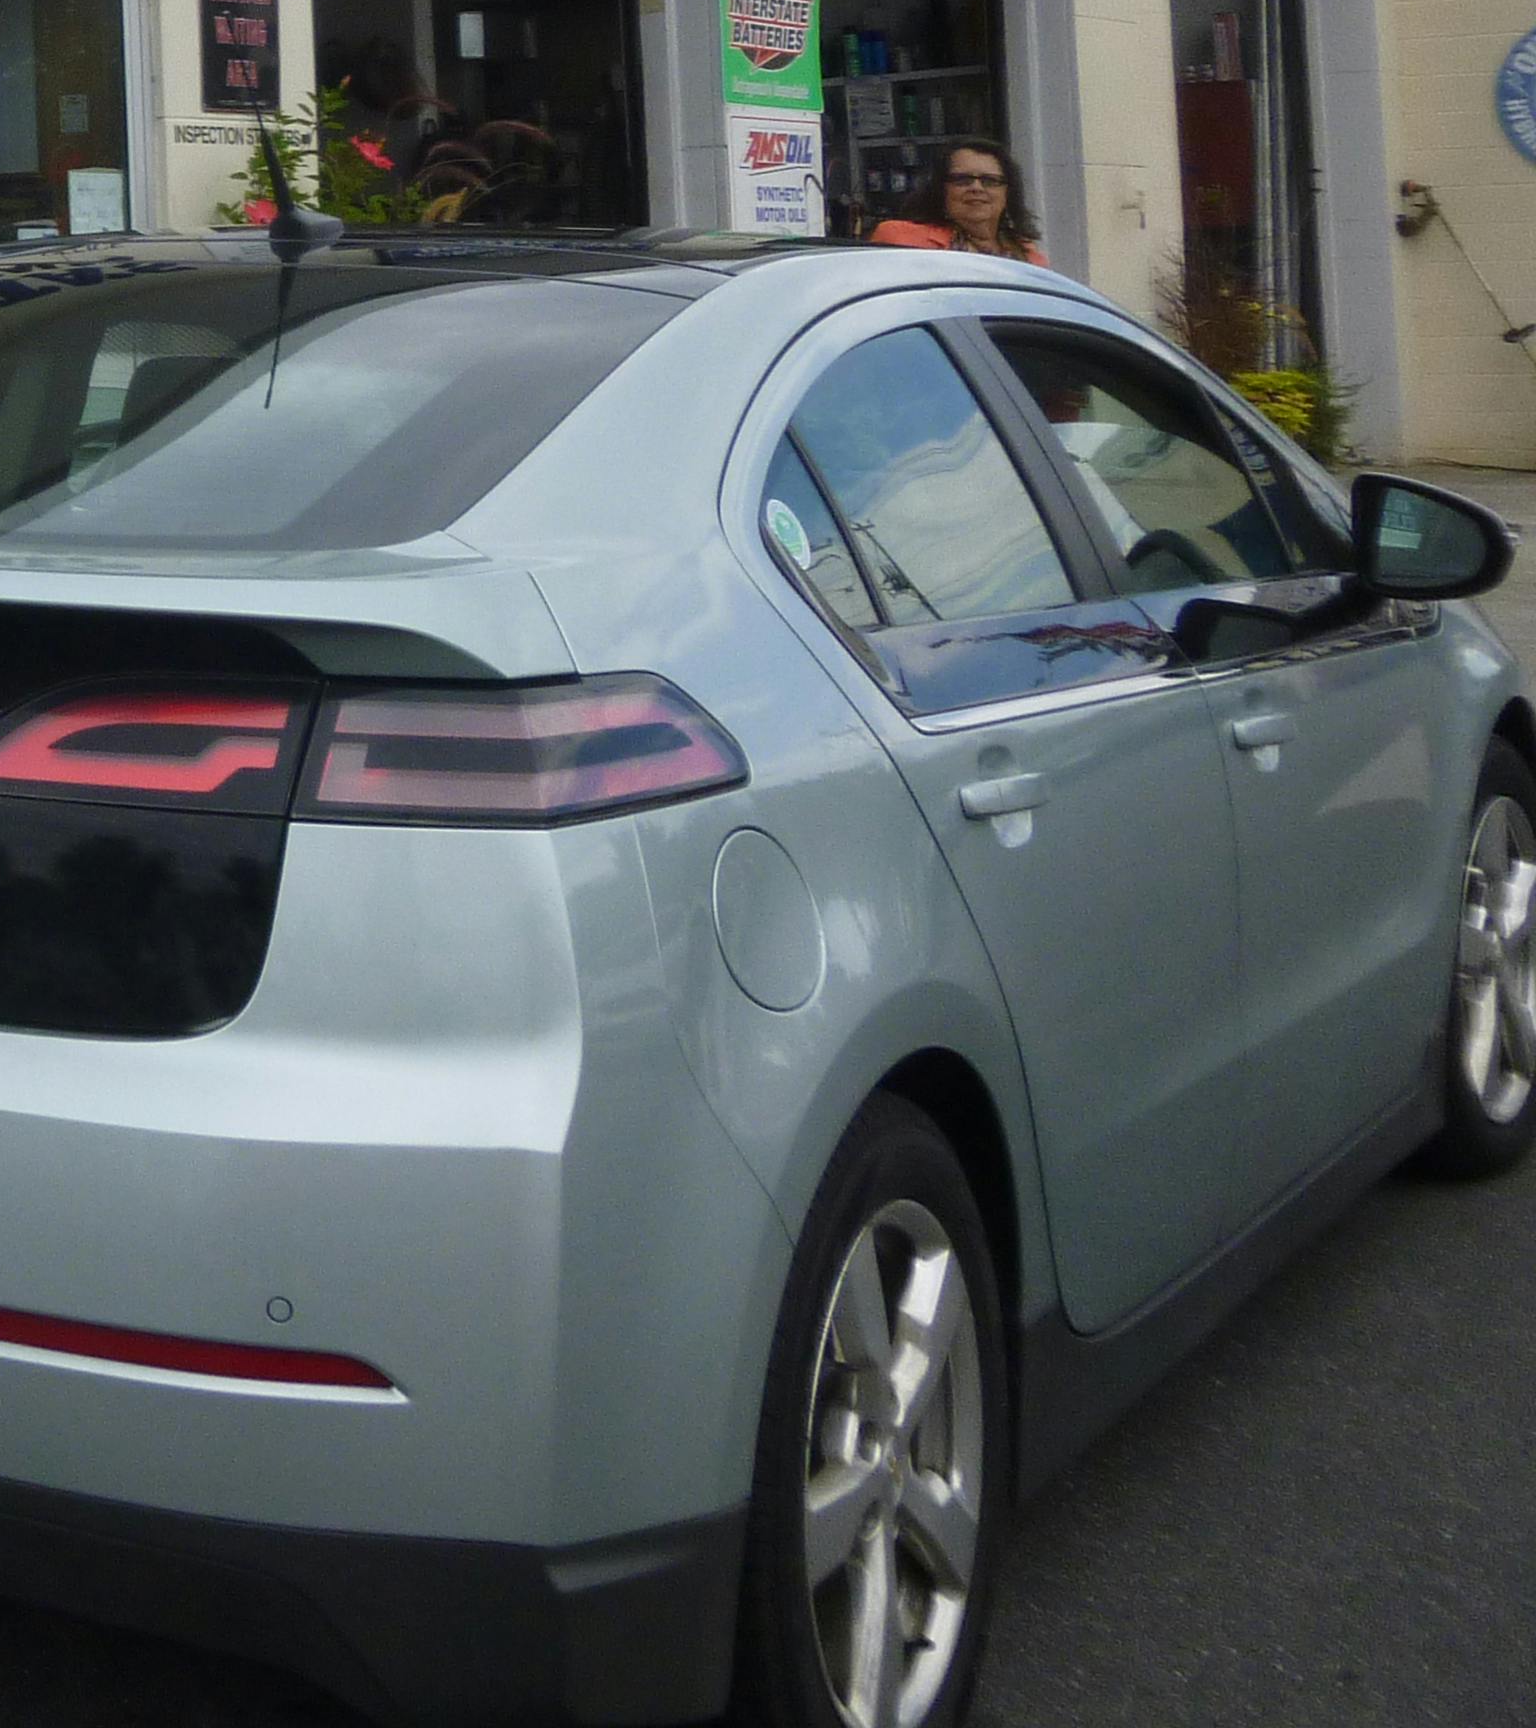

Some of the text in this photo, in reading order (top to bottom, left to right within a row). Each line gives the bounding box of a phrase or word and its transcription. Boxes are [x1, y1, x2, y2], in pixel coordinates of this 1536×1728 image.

[733, 20, 804, 51] BATTERIES
[174, 124, 245, 146] INSPECTION
[743, 130, 813, 170] AMSOIL
